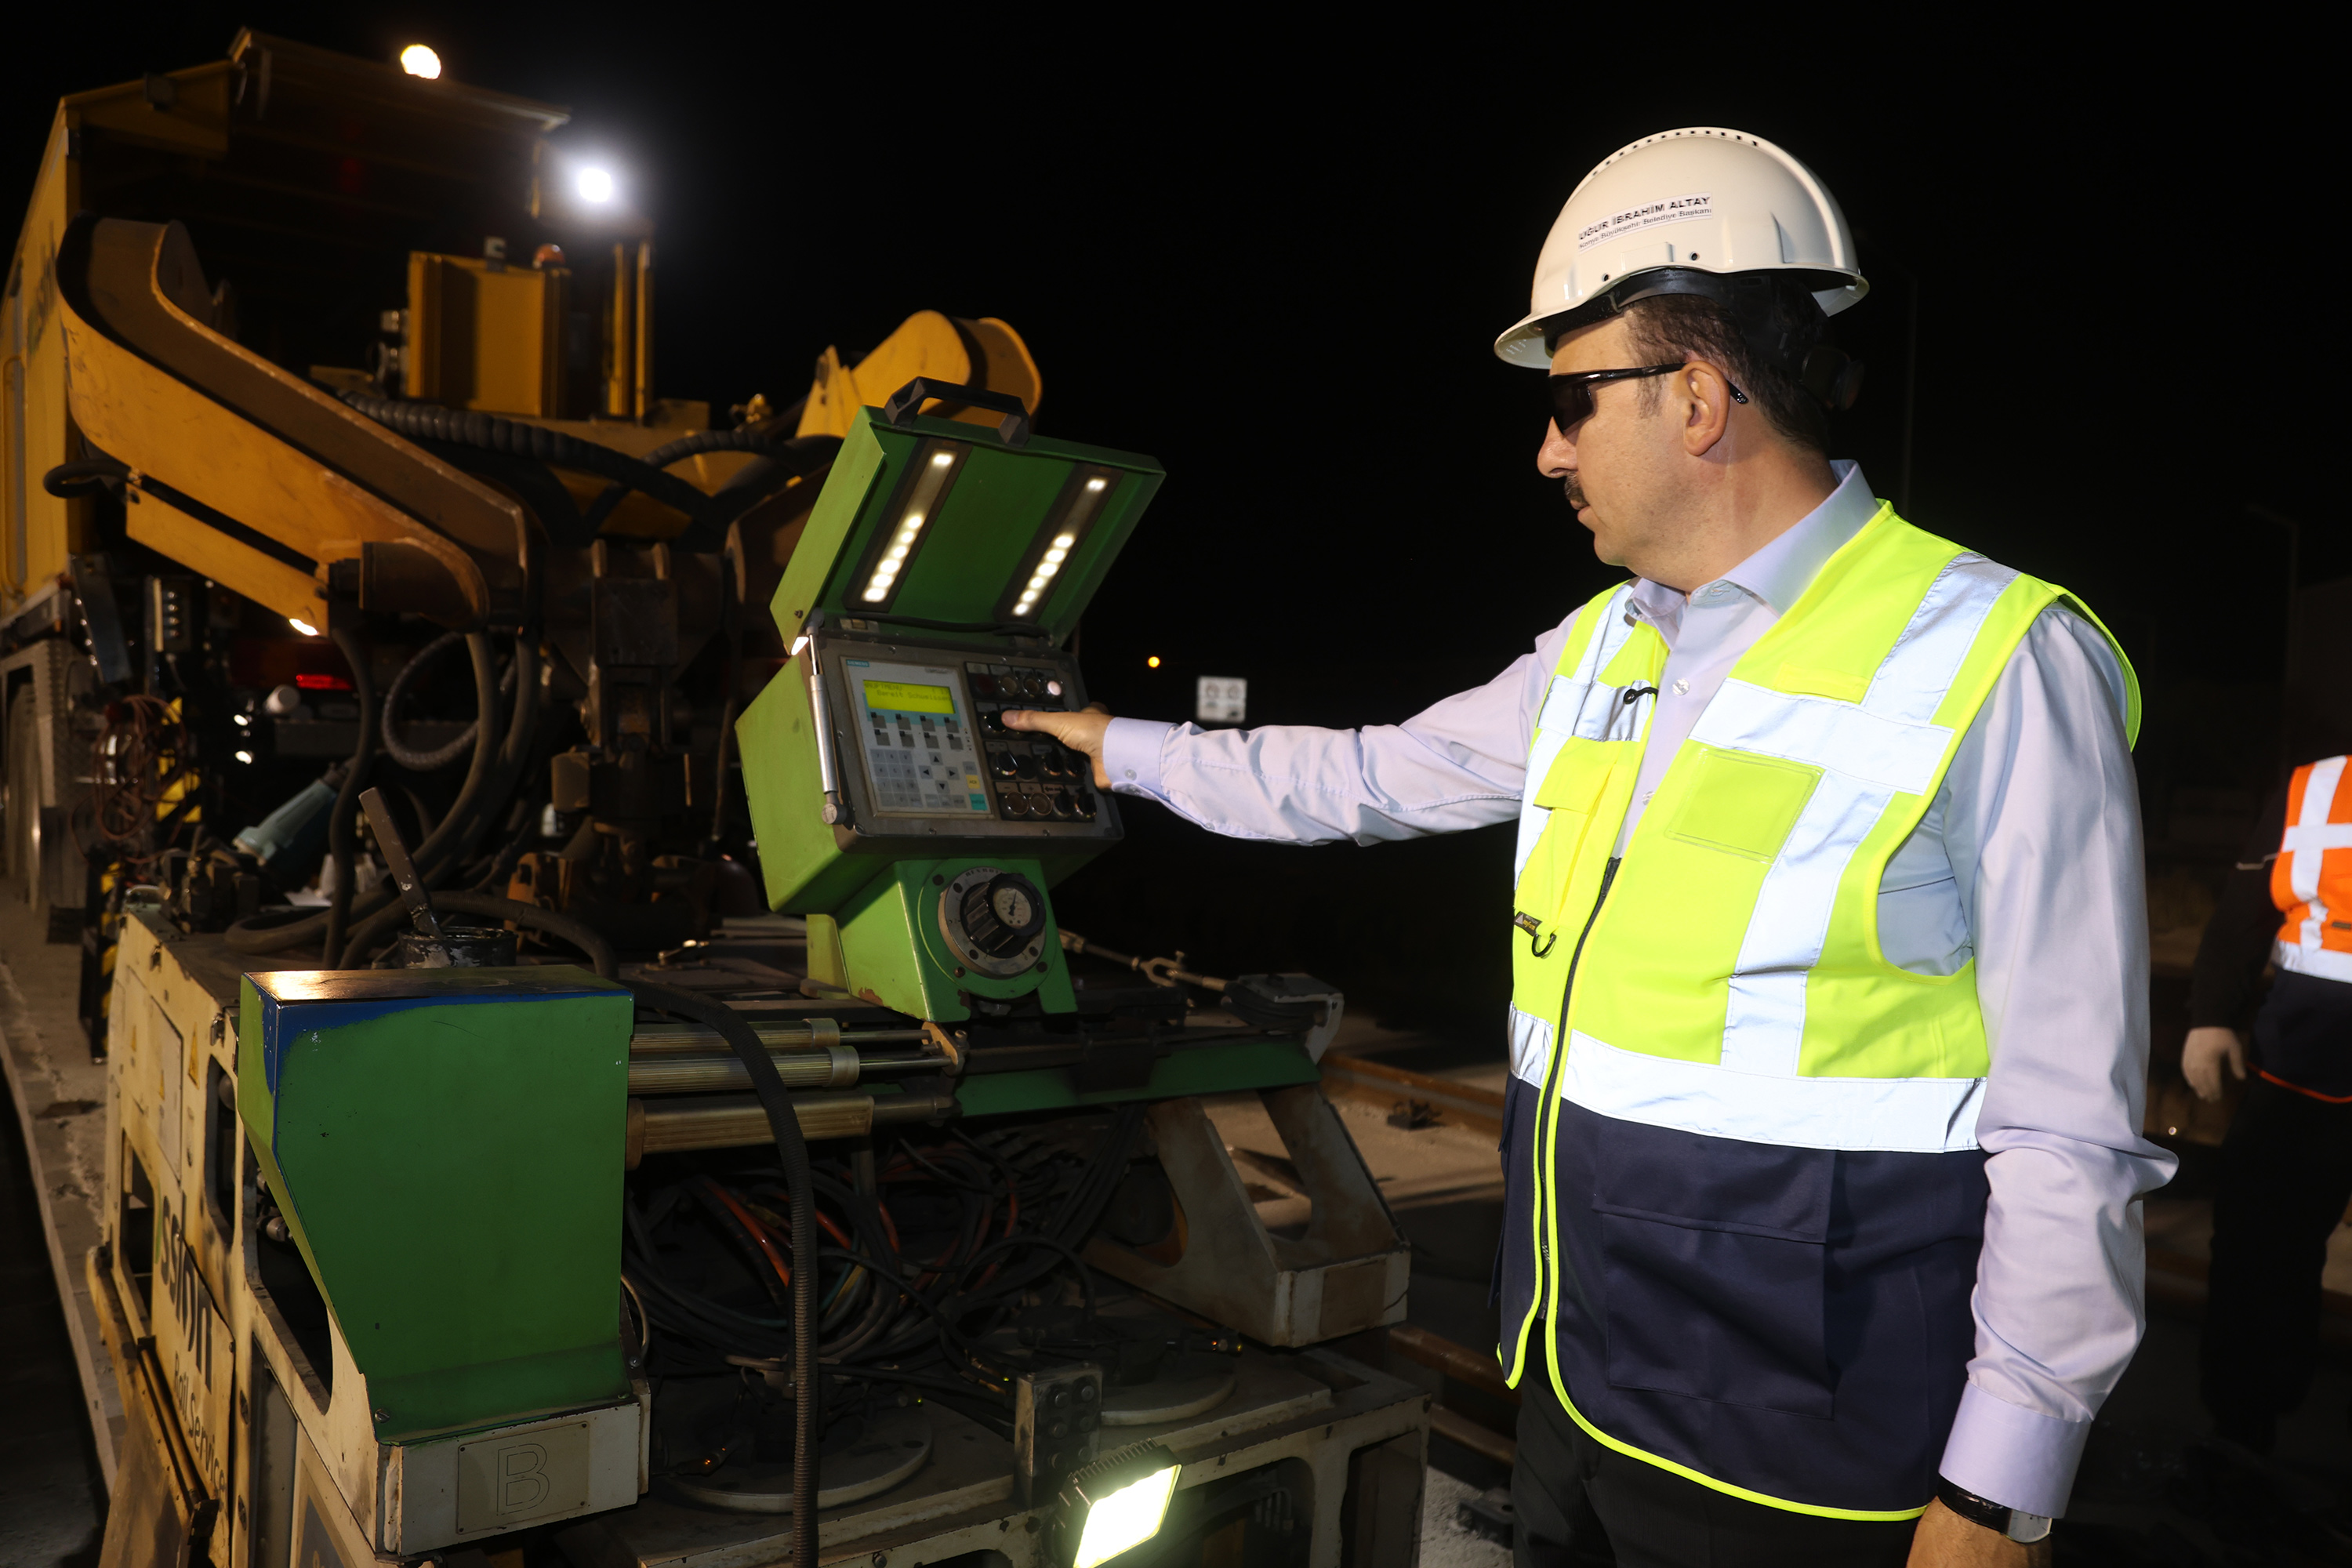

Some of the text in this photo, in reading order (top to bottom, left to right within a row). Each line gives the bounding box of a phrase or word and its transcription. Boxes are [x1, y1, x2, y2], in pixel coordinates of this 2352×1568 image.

[1579, 197, 1711, 240] UĞUR İBRAHİM ALTAY
[173, 1351, 188, 1421] Rail
[497, 1443, 550, 1515] B
